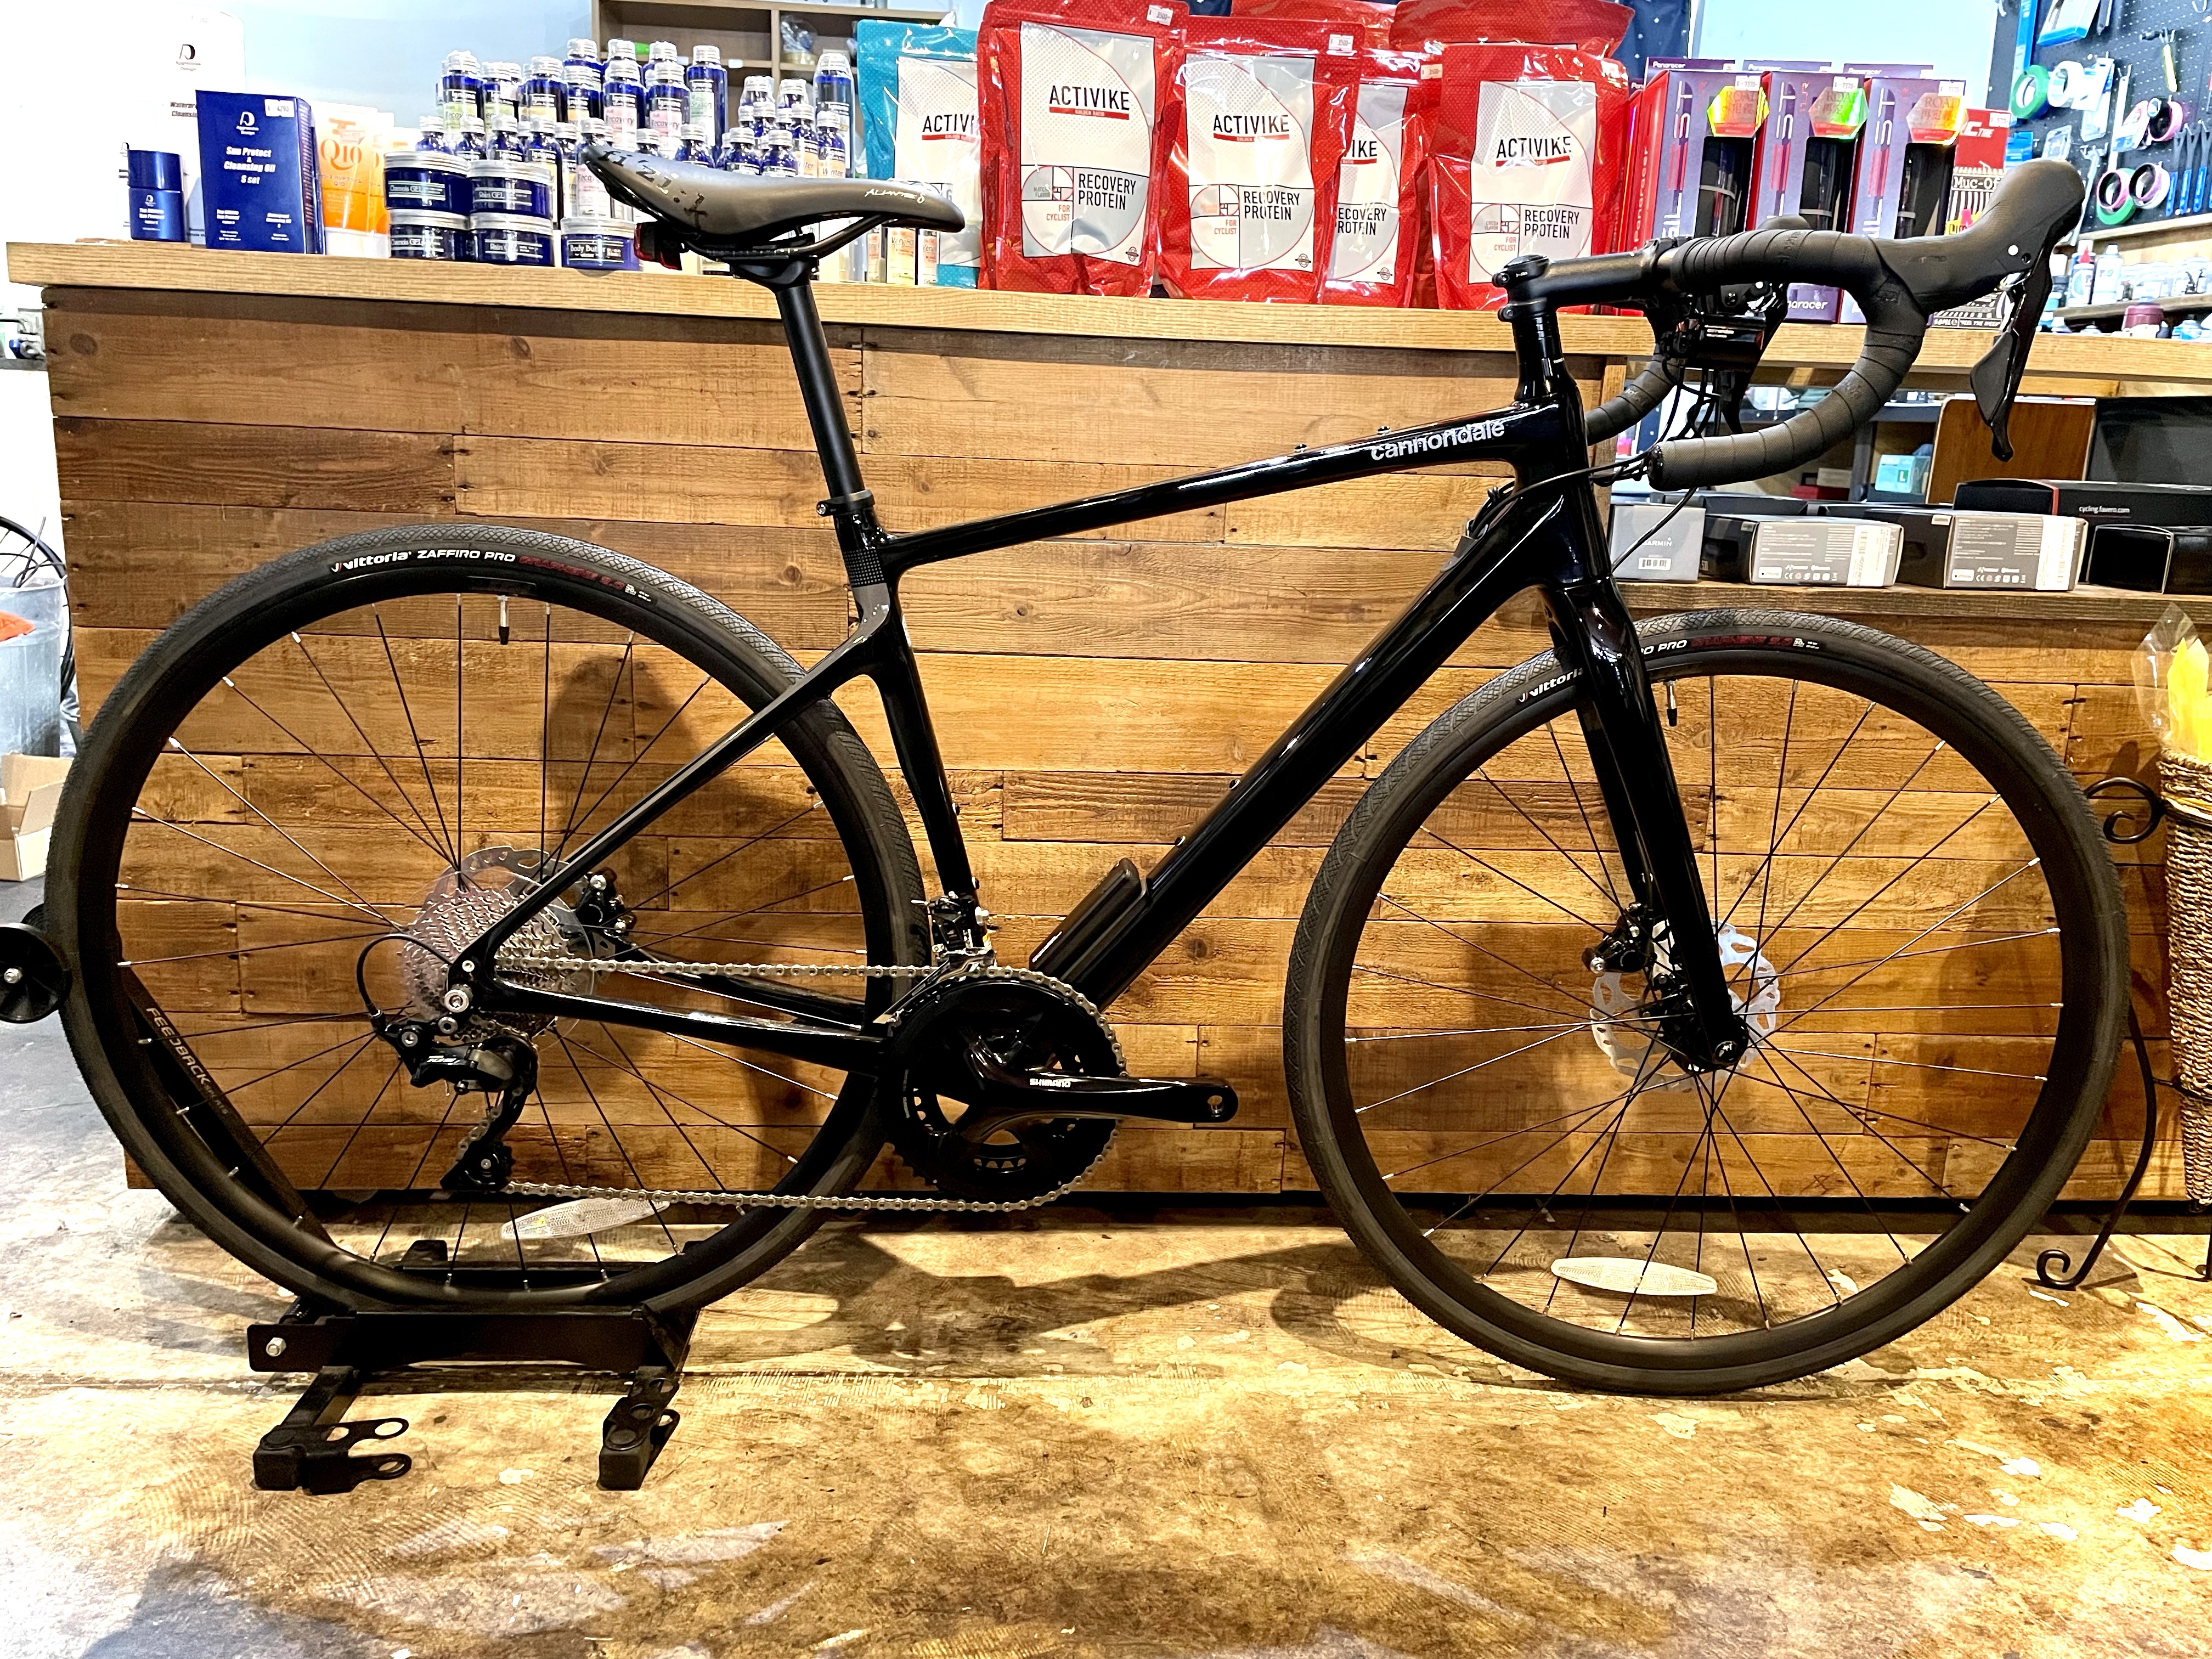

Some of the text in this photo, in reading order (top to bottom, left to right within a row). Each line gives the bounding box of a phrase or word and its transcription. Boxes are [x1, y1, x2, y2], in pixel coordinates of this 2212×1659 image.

[1049, 85, 1130, 111] ACTIVIKE
[1213, 114, 1289, 134] ACTIVIKE
[226, 146, 272, 157] Sun Protect
[320, 139, 362, 170] Q10
[1496, 136, 1572, 159] ACTIVIKE
[224, 161, 264, 172] Cleansing
[1079, 173, 1136, 195] RECOVERY
[1953, 176, 2001, 190] Muc-Of
[1078, 190, 1126, 210] PROTEIN
[1243, 190, 1300, 206] RECOVERY
[1244, 206, 1291, 221] PROTEIN
[1338, 207, 1387, 222] ECOVERY
[1525, 209, 1579, 225] RECOVERY
[1337, 221, 1376, 235] ROTEIN
[1524, 223, 1570, 239] PROTEIN
[570, 245, 584, 253] Body
[1787, 301, 1828, 310] naracer
[1371, 420, 1505, 461] cannondale
[1899, 471, 1906, 482] L
[342, 551, 411, 569] vittoria
[417, 549, 481, 559] ZAFFIRO
[484, 551, 516, 562] PRO
[1657, 639, 1688, 652] PRO
[146, 1007, 211, 1085] FEEDBACK
[1029, 1078, 1071, 1088] SHIMANO
